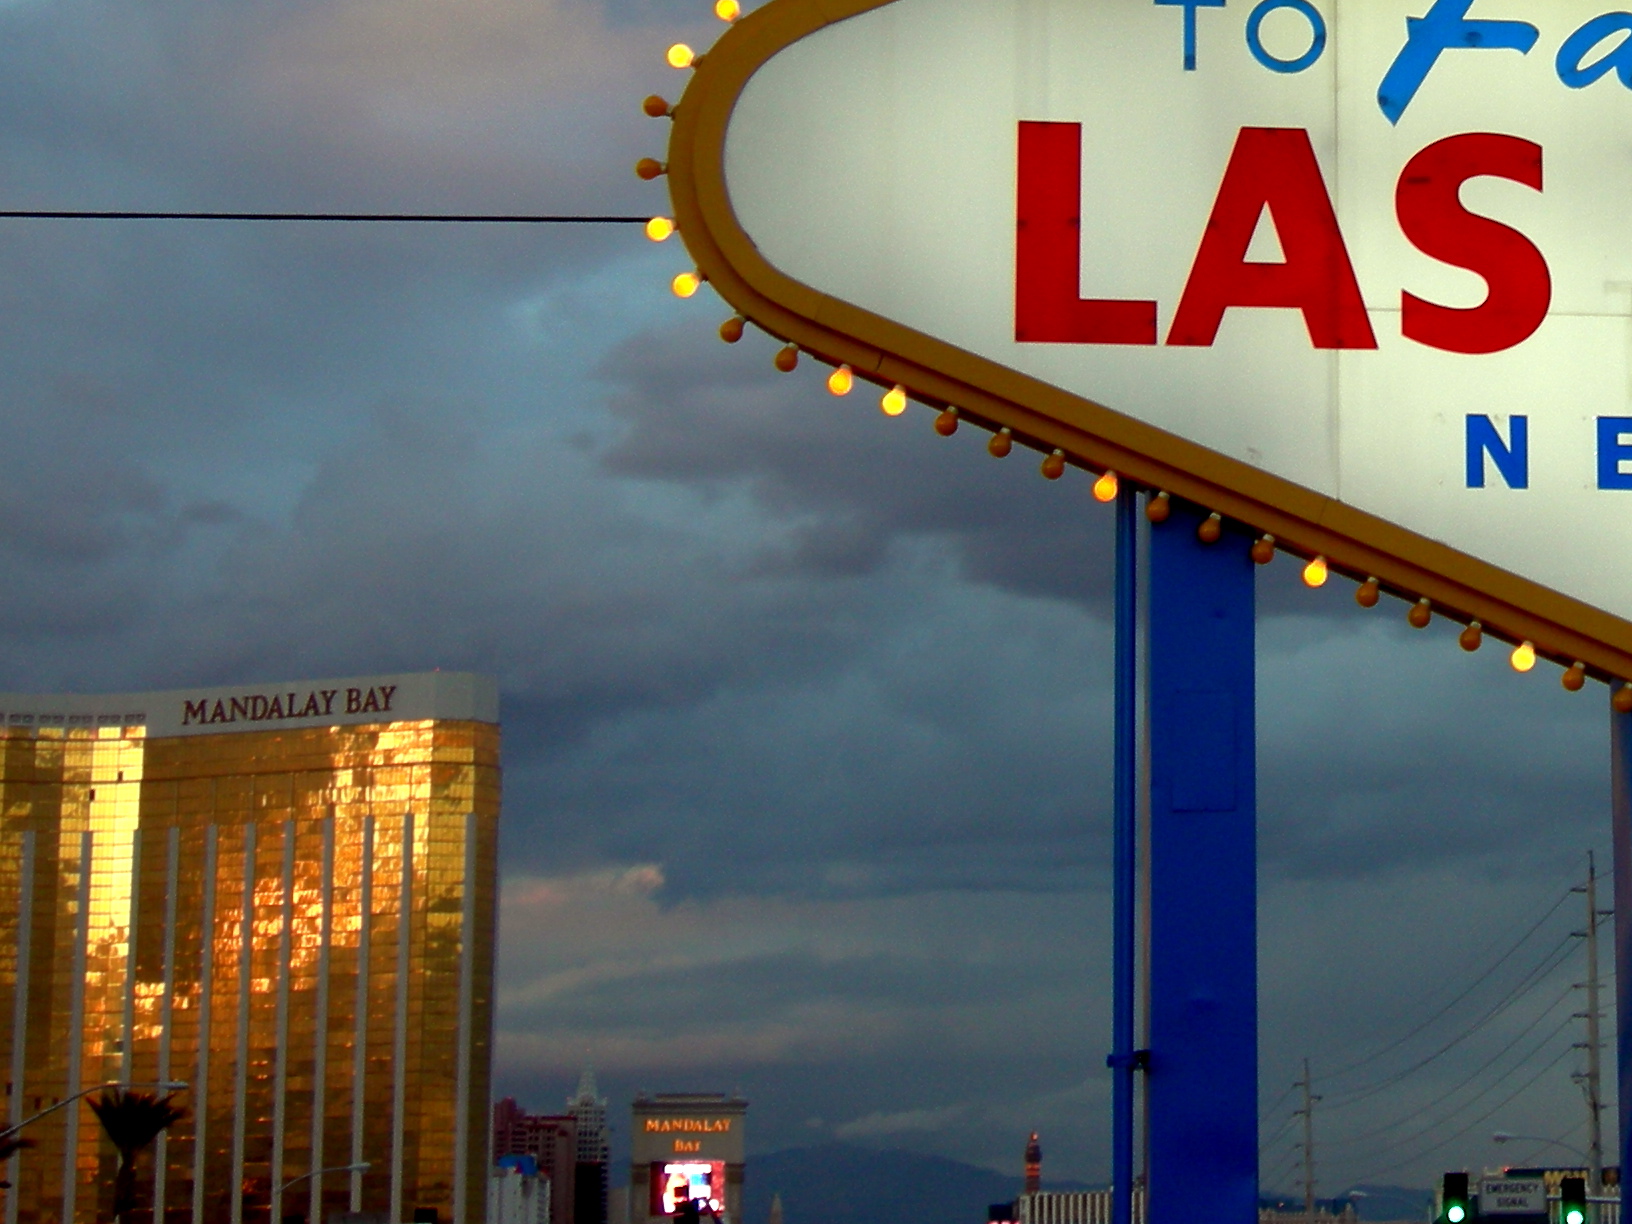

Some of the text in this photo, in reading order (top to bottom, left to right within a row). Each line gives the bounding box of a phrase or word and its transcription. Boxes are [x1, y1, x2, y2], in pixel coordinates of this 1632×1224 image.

[1014, 119, 1553, 355] LAS
[182, 685, 398, 726] MANDALAY BAY
[644, 1118, 732, 1133] MANDALAY
